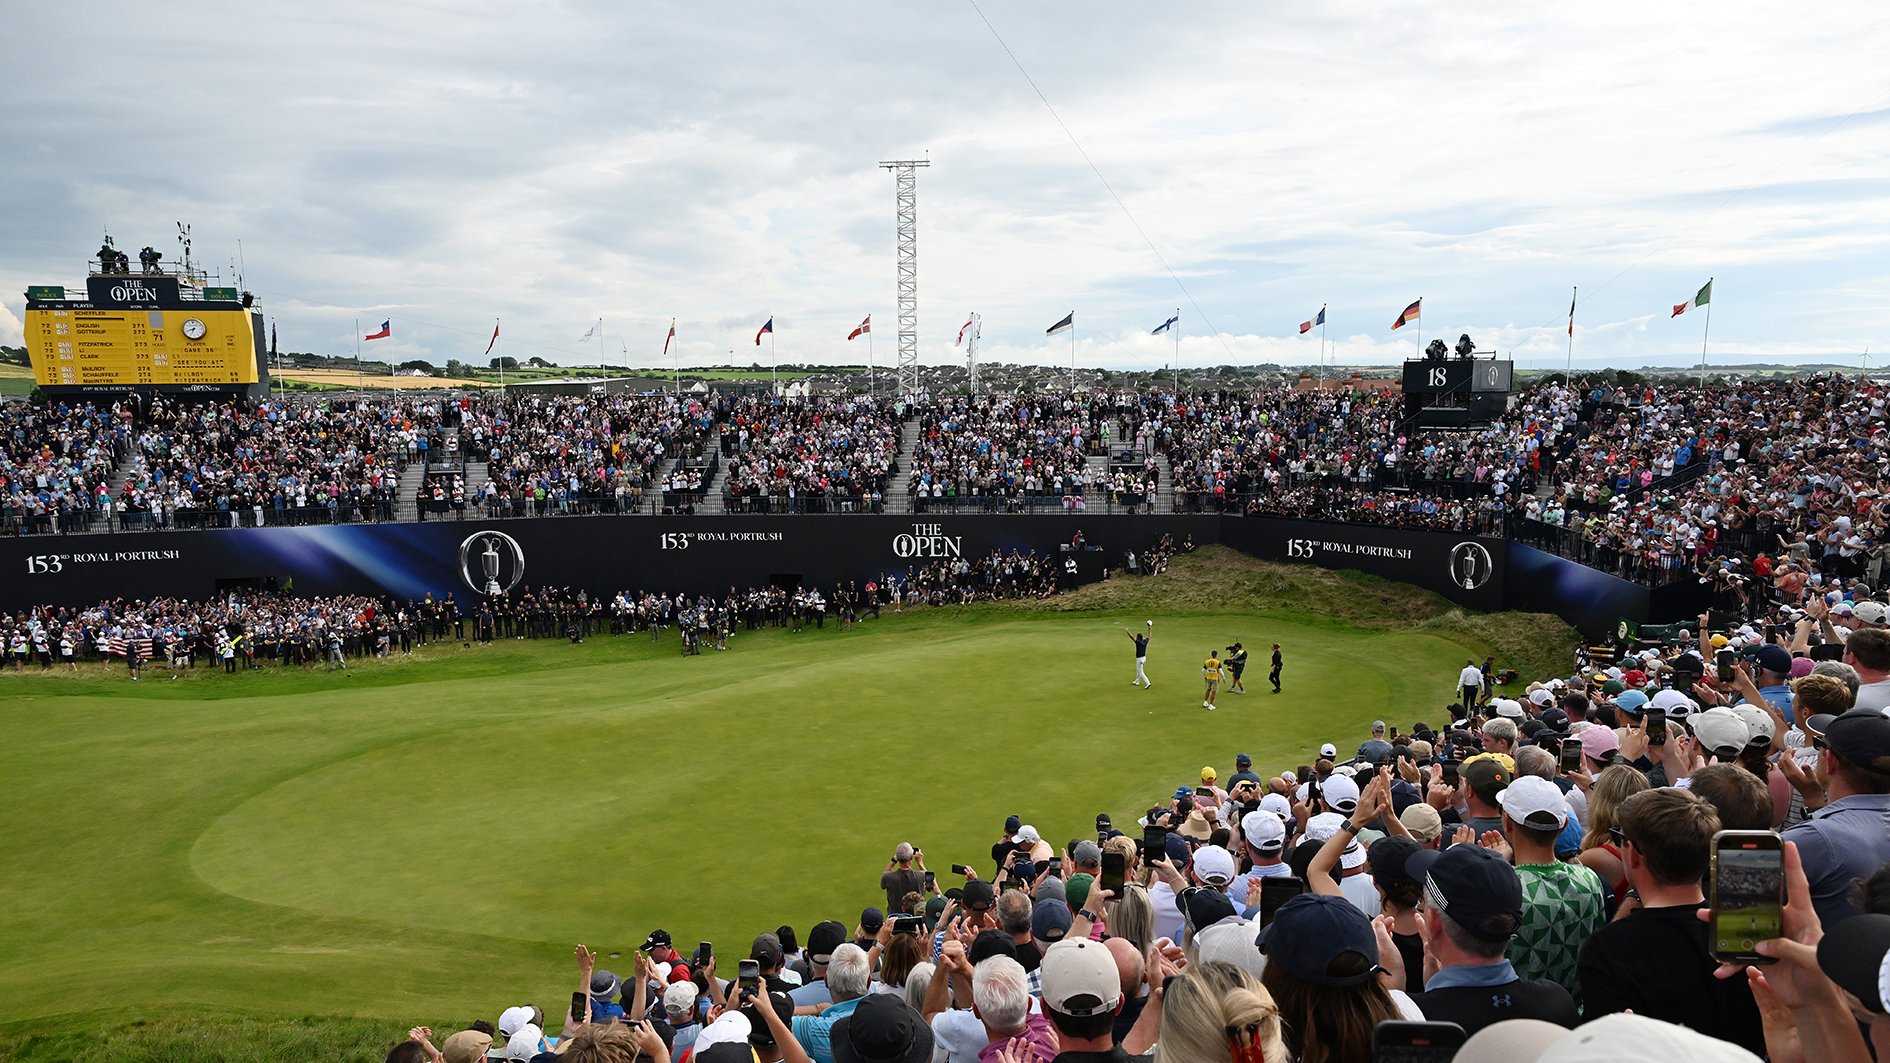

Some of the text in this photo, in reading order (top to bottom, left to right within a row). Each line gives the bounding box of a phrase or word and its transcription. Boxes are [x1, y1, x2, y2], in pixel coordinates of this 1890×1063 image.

[110, 286, 157, 301] OPEN
[1428, 367, 1446, 386] 18
[698, 532, 728, 540] ROYAL
[730, 532, 782, 540] PORTRUSH
[912, 524, 942, 536] THE
[892, 534, 962, 558] OPEN
[1323, 542, 1353, 553] ROYAL
[1356, 545, 1412, 559] PORTRUSH
[74, 552, 113, 562] ROYAL
[115, 550, 180, 562] PORTRUSH
